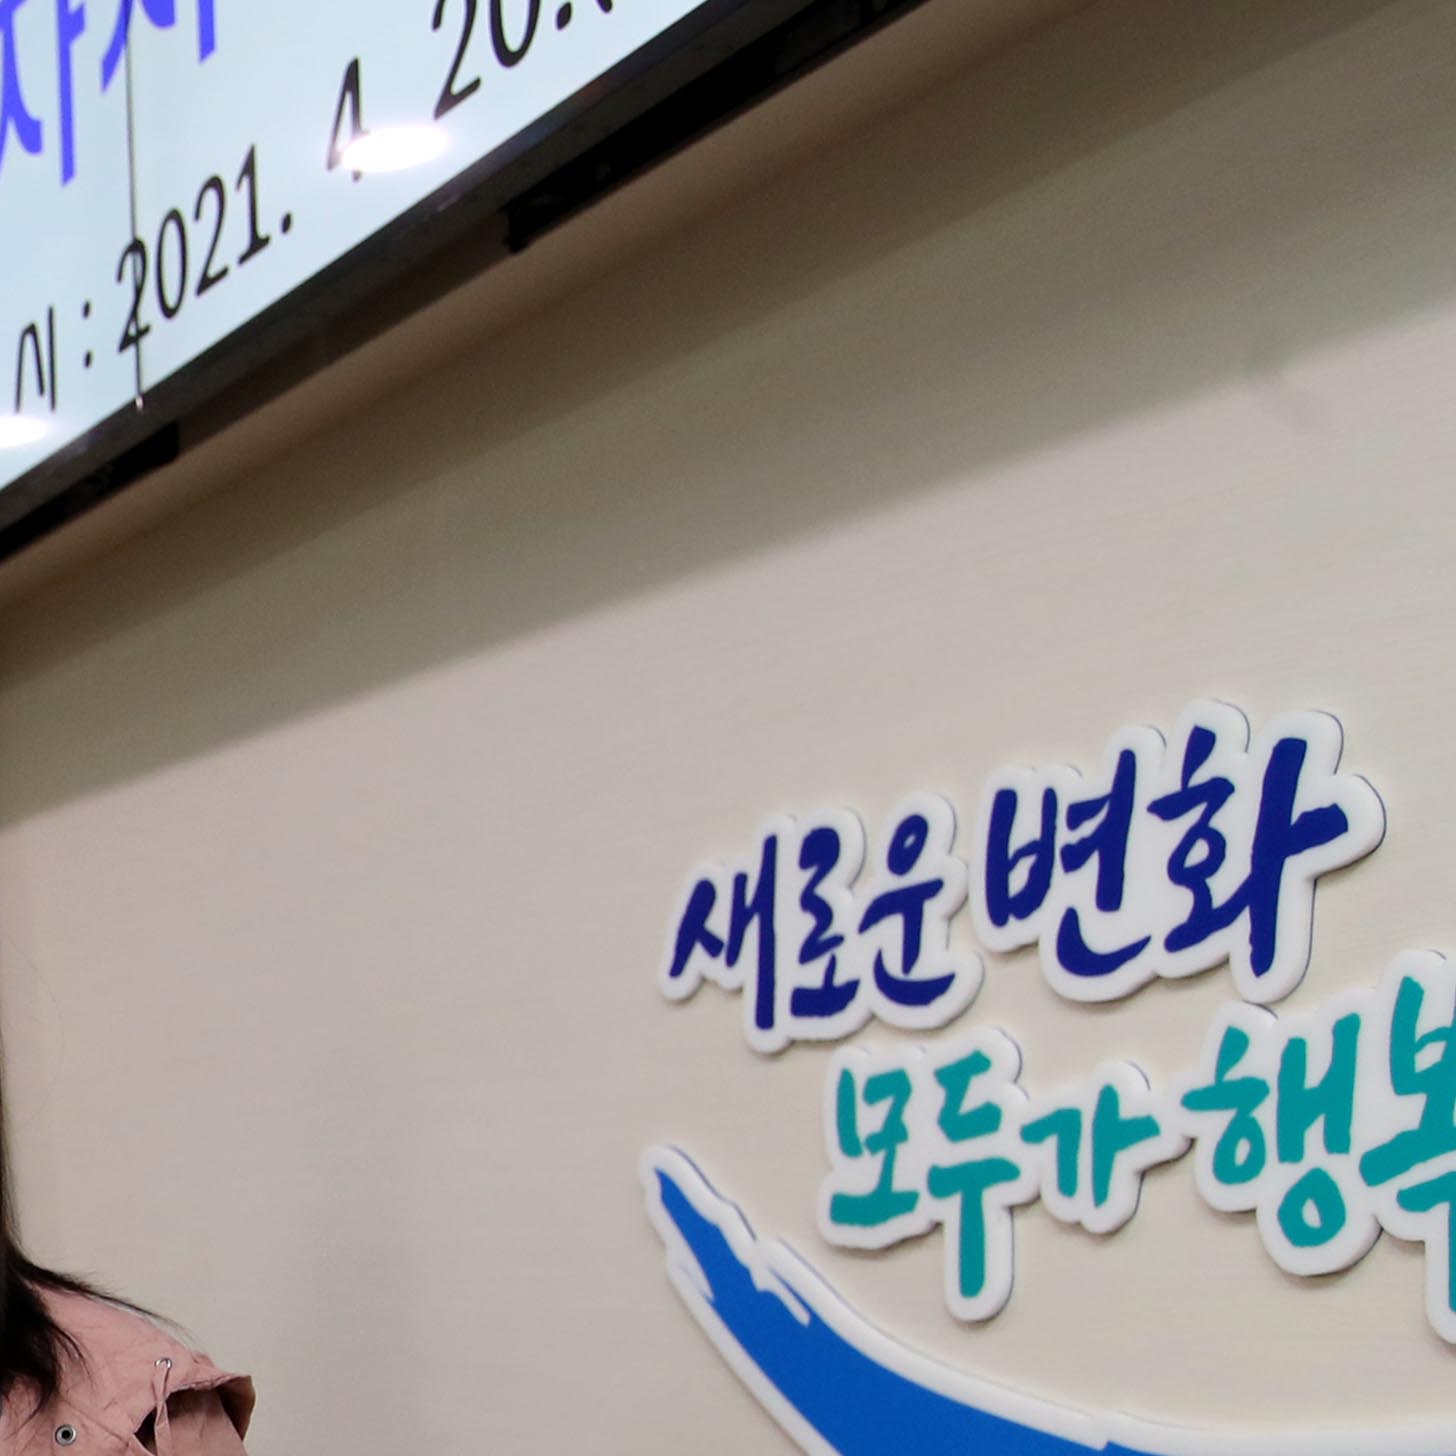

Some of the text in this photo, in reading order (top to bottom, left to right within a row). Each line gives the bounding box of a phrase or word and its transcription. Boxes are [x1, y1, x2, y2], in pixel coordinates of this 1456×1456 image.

[670, 725, 1350, 1029] 새로운 변화
[830, 1050, 1161, 1299] 모두가
